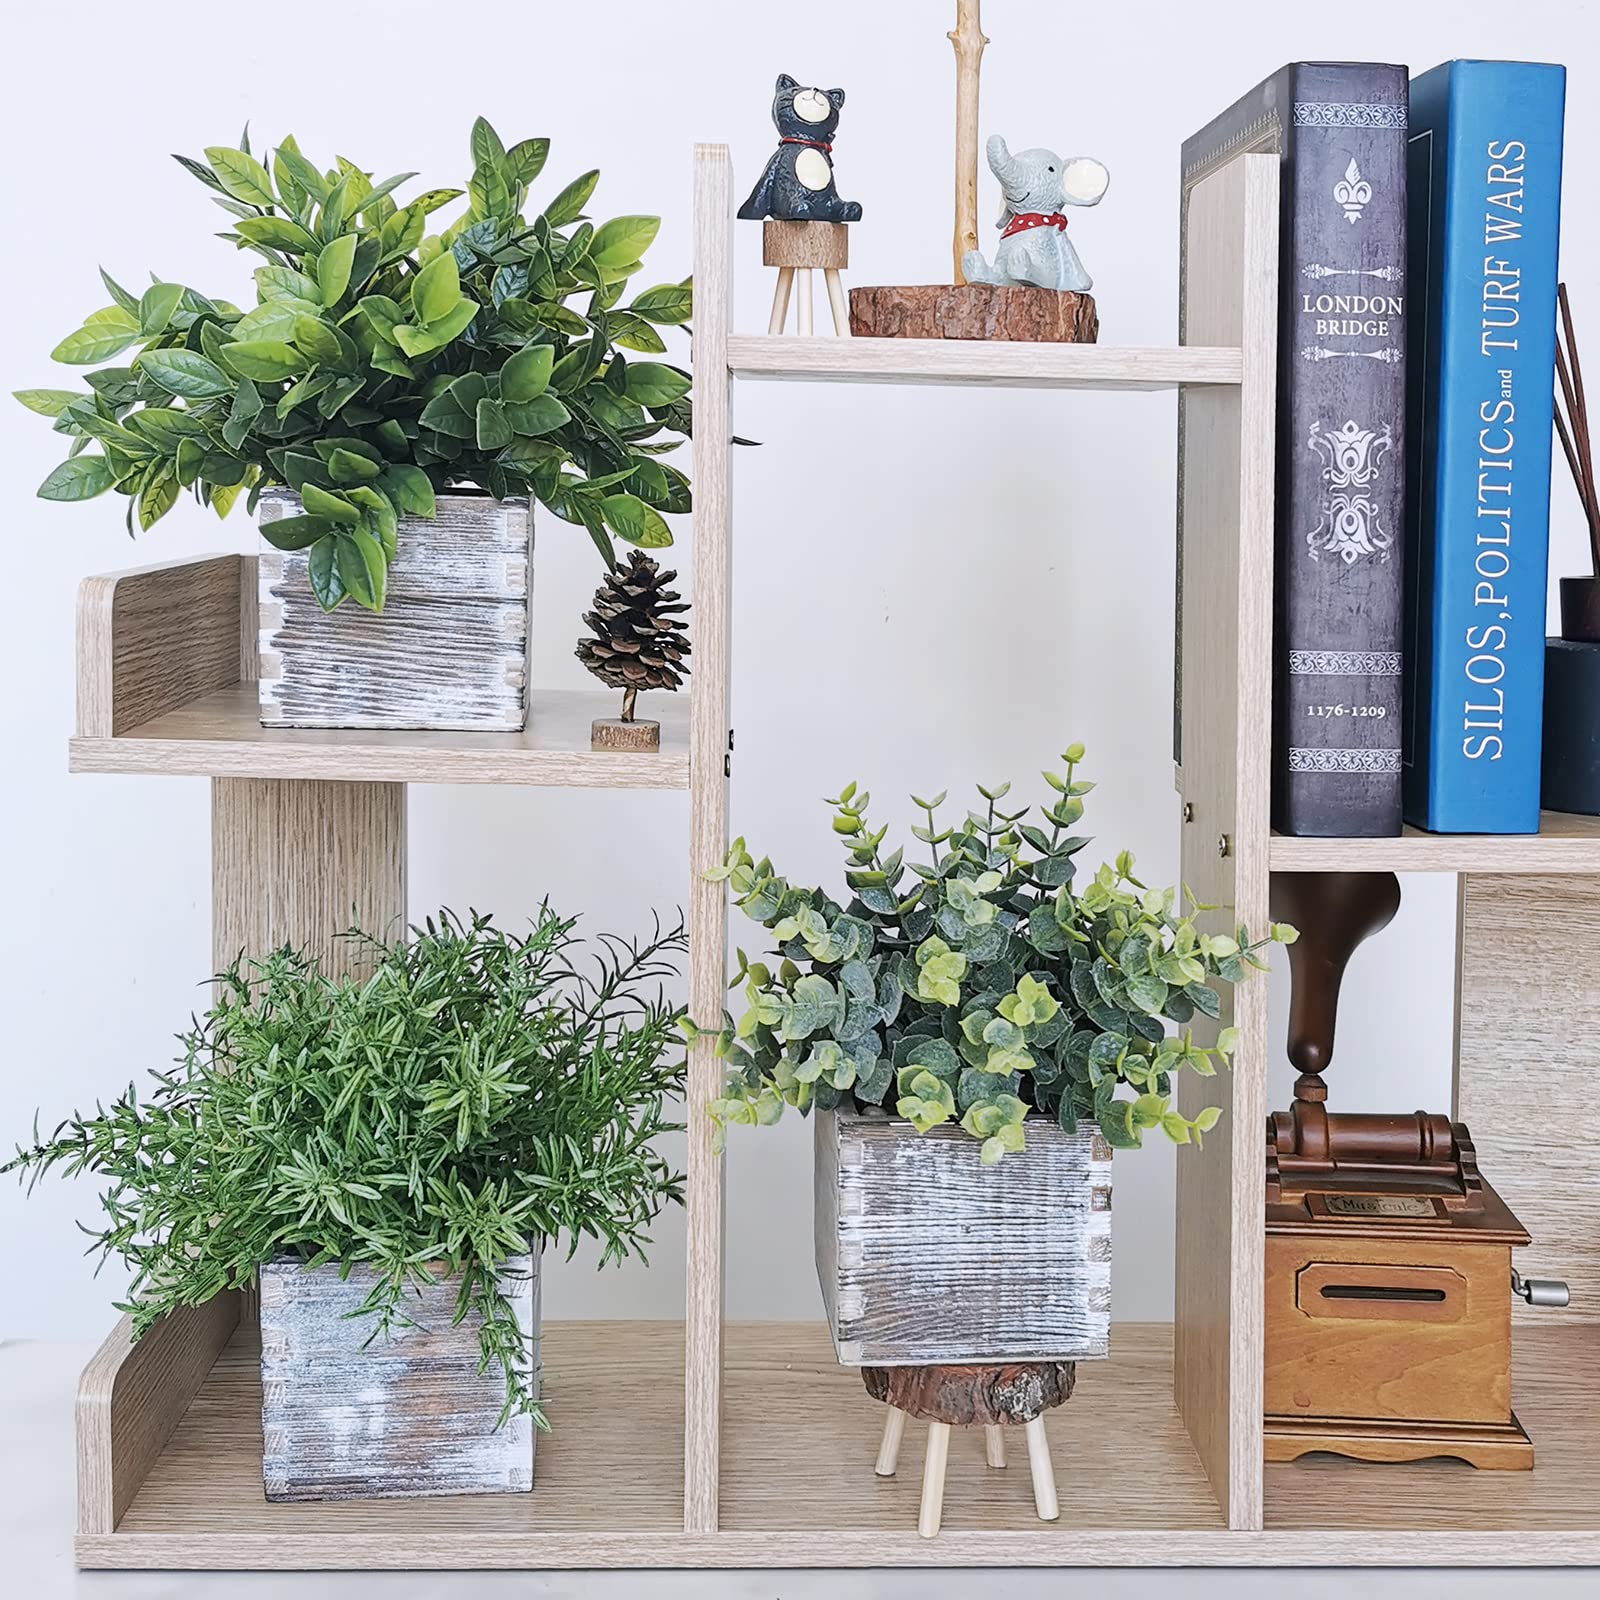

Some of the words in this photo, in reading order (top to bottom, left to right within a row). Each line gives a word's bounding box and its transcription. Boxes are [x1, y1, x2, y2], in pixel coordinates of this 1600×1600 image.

[1484, 140, 1526, 245] WARS
[1302, 294, 1402, 315] LONDON
[1481, 255, 1521, 356] TURF
[1315, 319, 1389, 337] BRIDGE
[1307, 704, 1386, 719] 1176-1209
